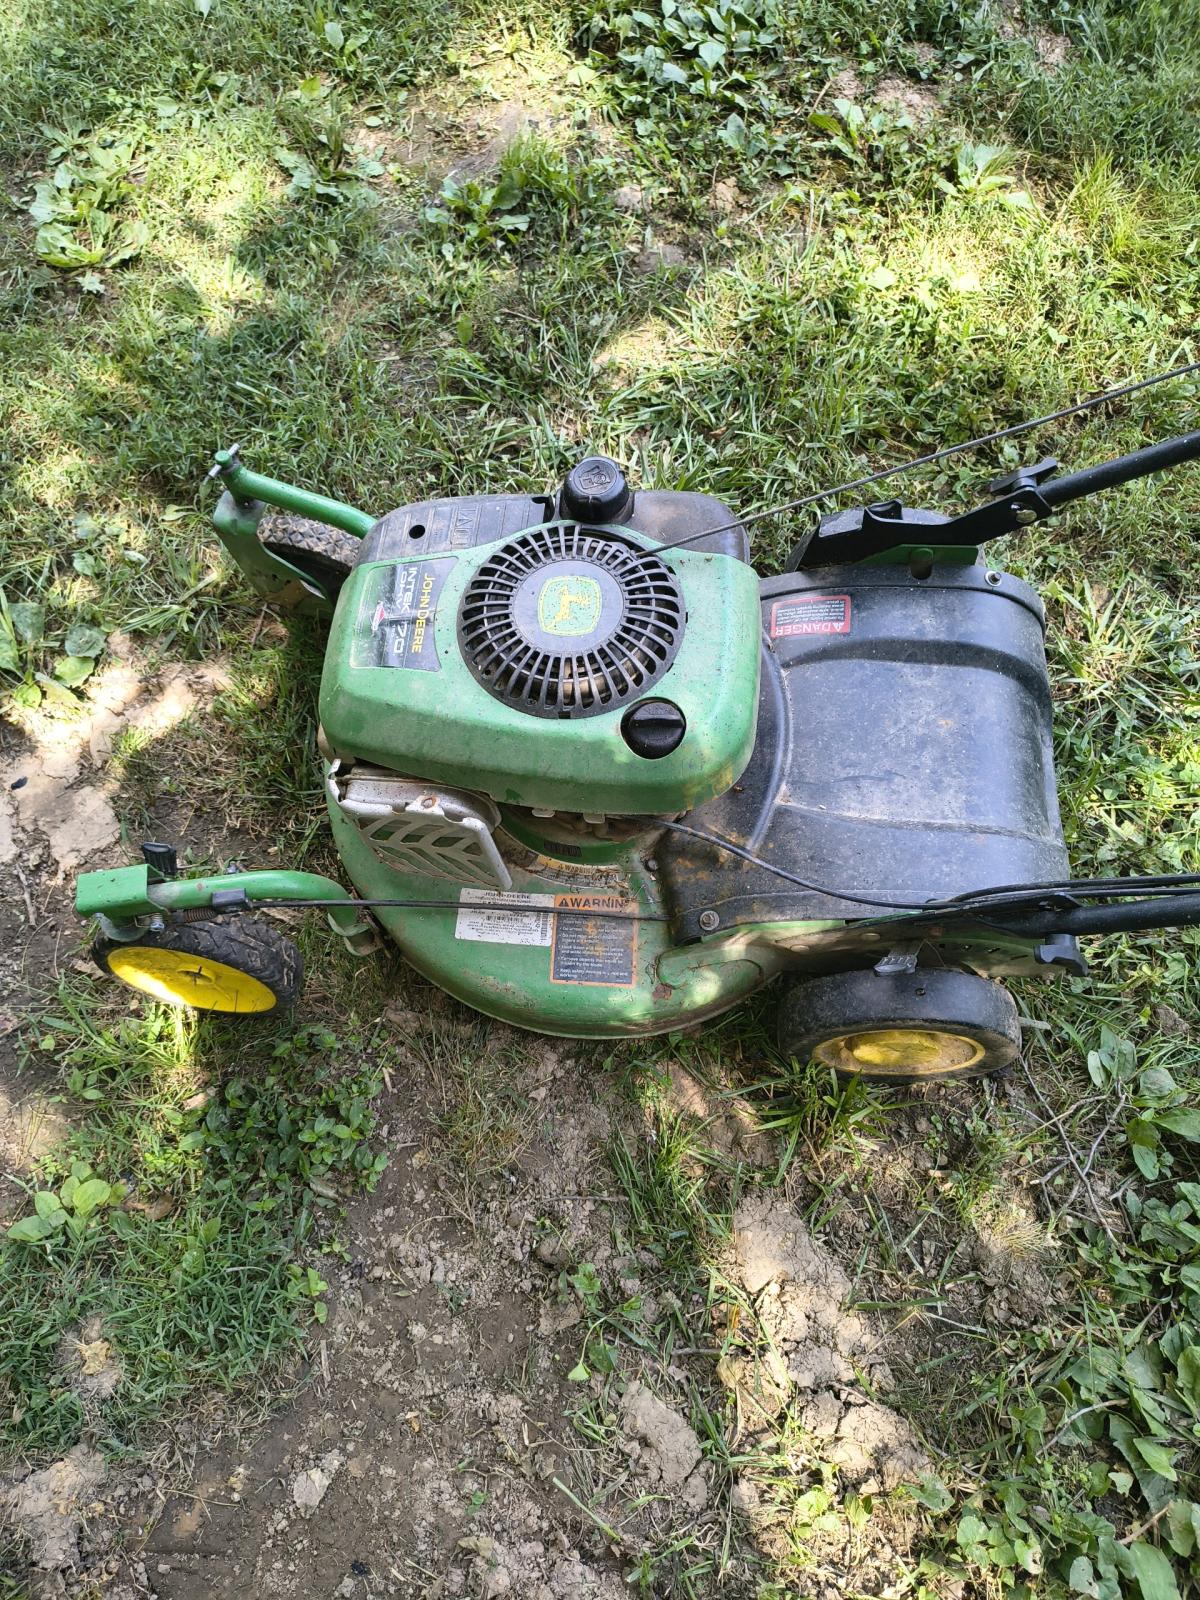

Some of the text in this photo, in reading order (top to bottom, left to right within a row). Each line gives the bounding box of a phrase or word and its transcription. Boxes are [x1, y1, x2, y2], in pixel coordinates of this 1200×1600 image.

[401, 567, 418, 613] INTEK
[411, 573, 436, 654] JOHN DEERE
[775, 622, 831, 635] DANGER
